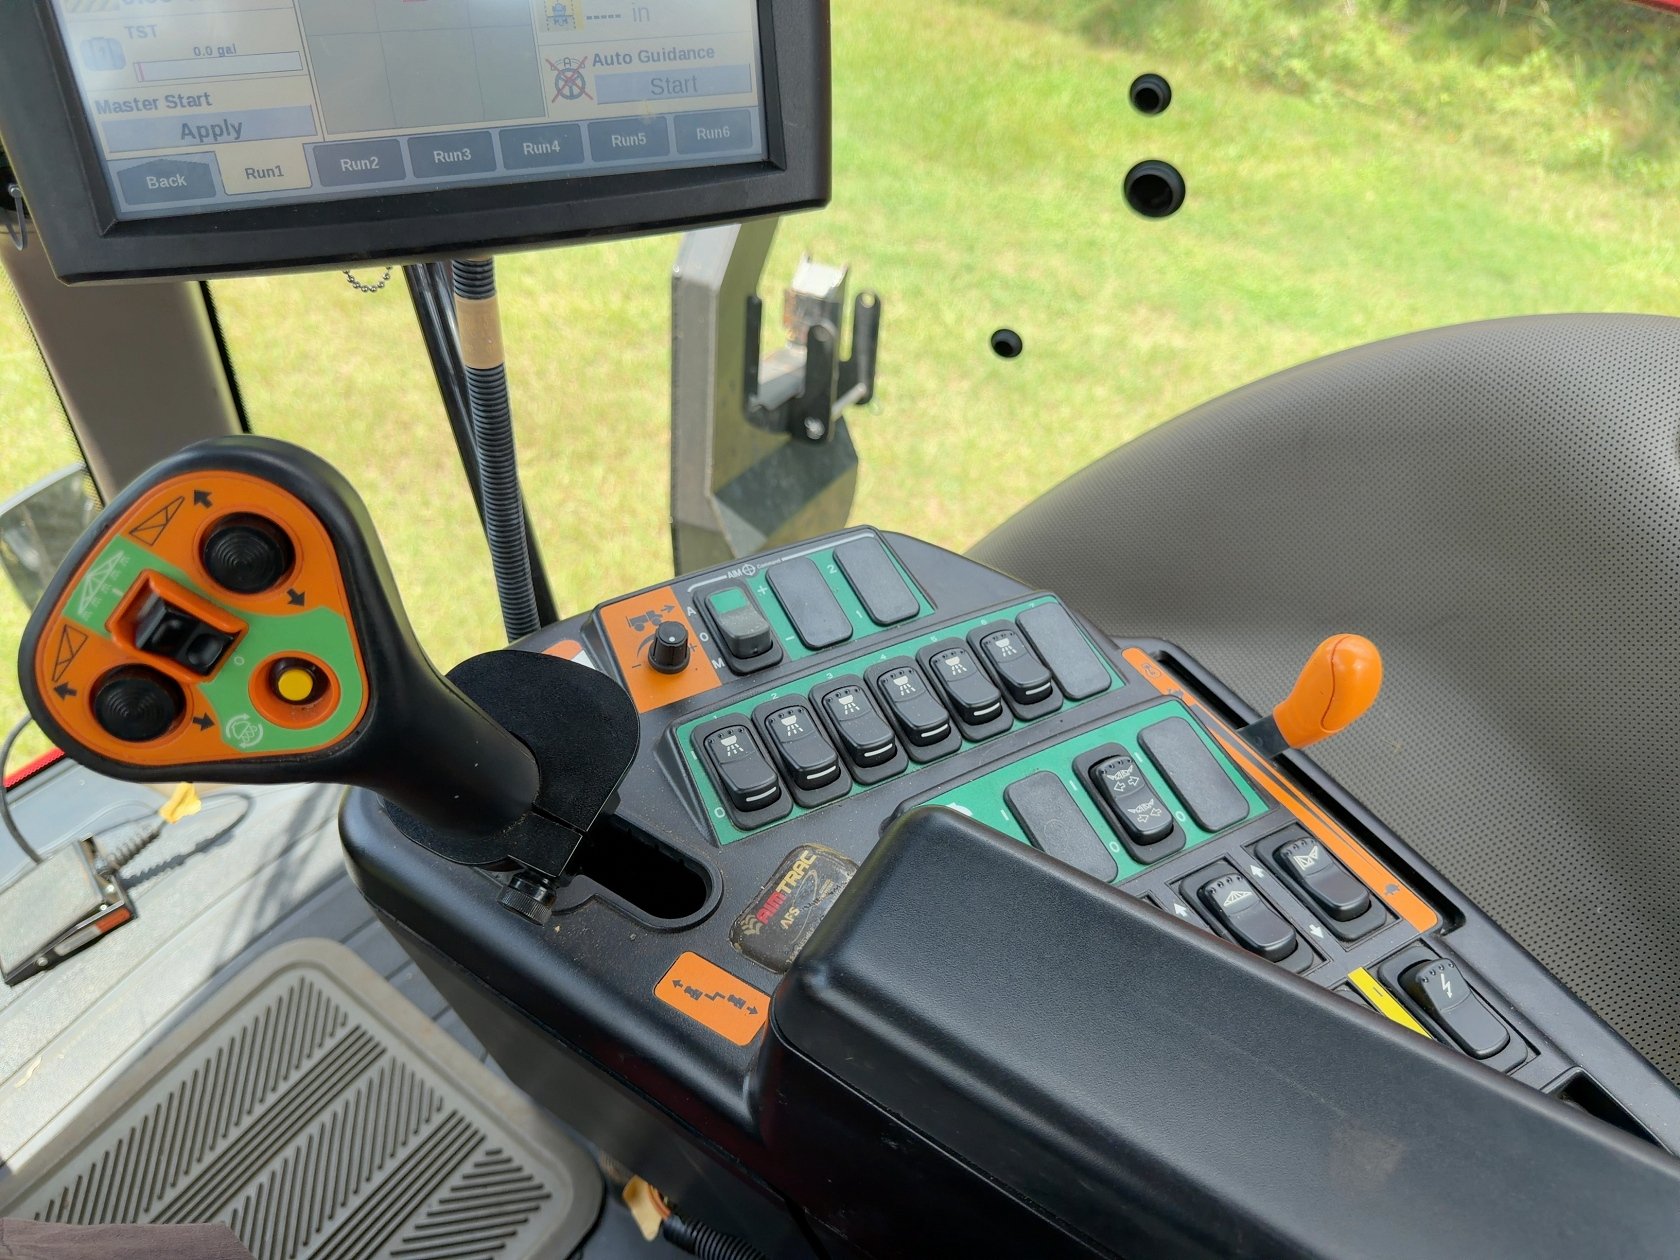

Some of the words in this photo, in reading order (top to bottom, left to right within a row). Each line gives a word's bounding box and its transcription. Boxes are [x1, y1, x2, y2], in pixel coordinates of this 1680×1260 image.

[632, 2, 649, 23] in
[124, 25, 158, 39] TST
[194, 46, 212, 57] 0.0
[218, 43, 237, 58] gal
[592, 53, 633, 68] Auto
[638, 45, 716, 64] Guidance
[650, 76, 697, 96] Start
[95, 94, 159, 116] Master
[165, 92, 212, 109] Start
[181, 120, 243, 143] Apply
[696, 126, 730, 140] Run6
[611, 133, 647, 148] Run5
[433, 149, 472, 163] Run3
[523, 141, 561, 156] Run4
[340, 157, 380, 172] Run2
[245, 165, 284, 180] Run1
[146, 173, 187, 190] Back
[727, 568, 742, 580] AIM
[826, 564, 838, 574] 2
[687, 606, 697, 617] A
[711, 657, 726, 669] M
[771, 692, 779, 700] 2
[826, 672, 834, 680] 3
[780, 906, 801, 930] AFS
